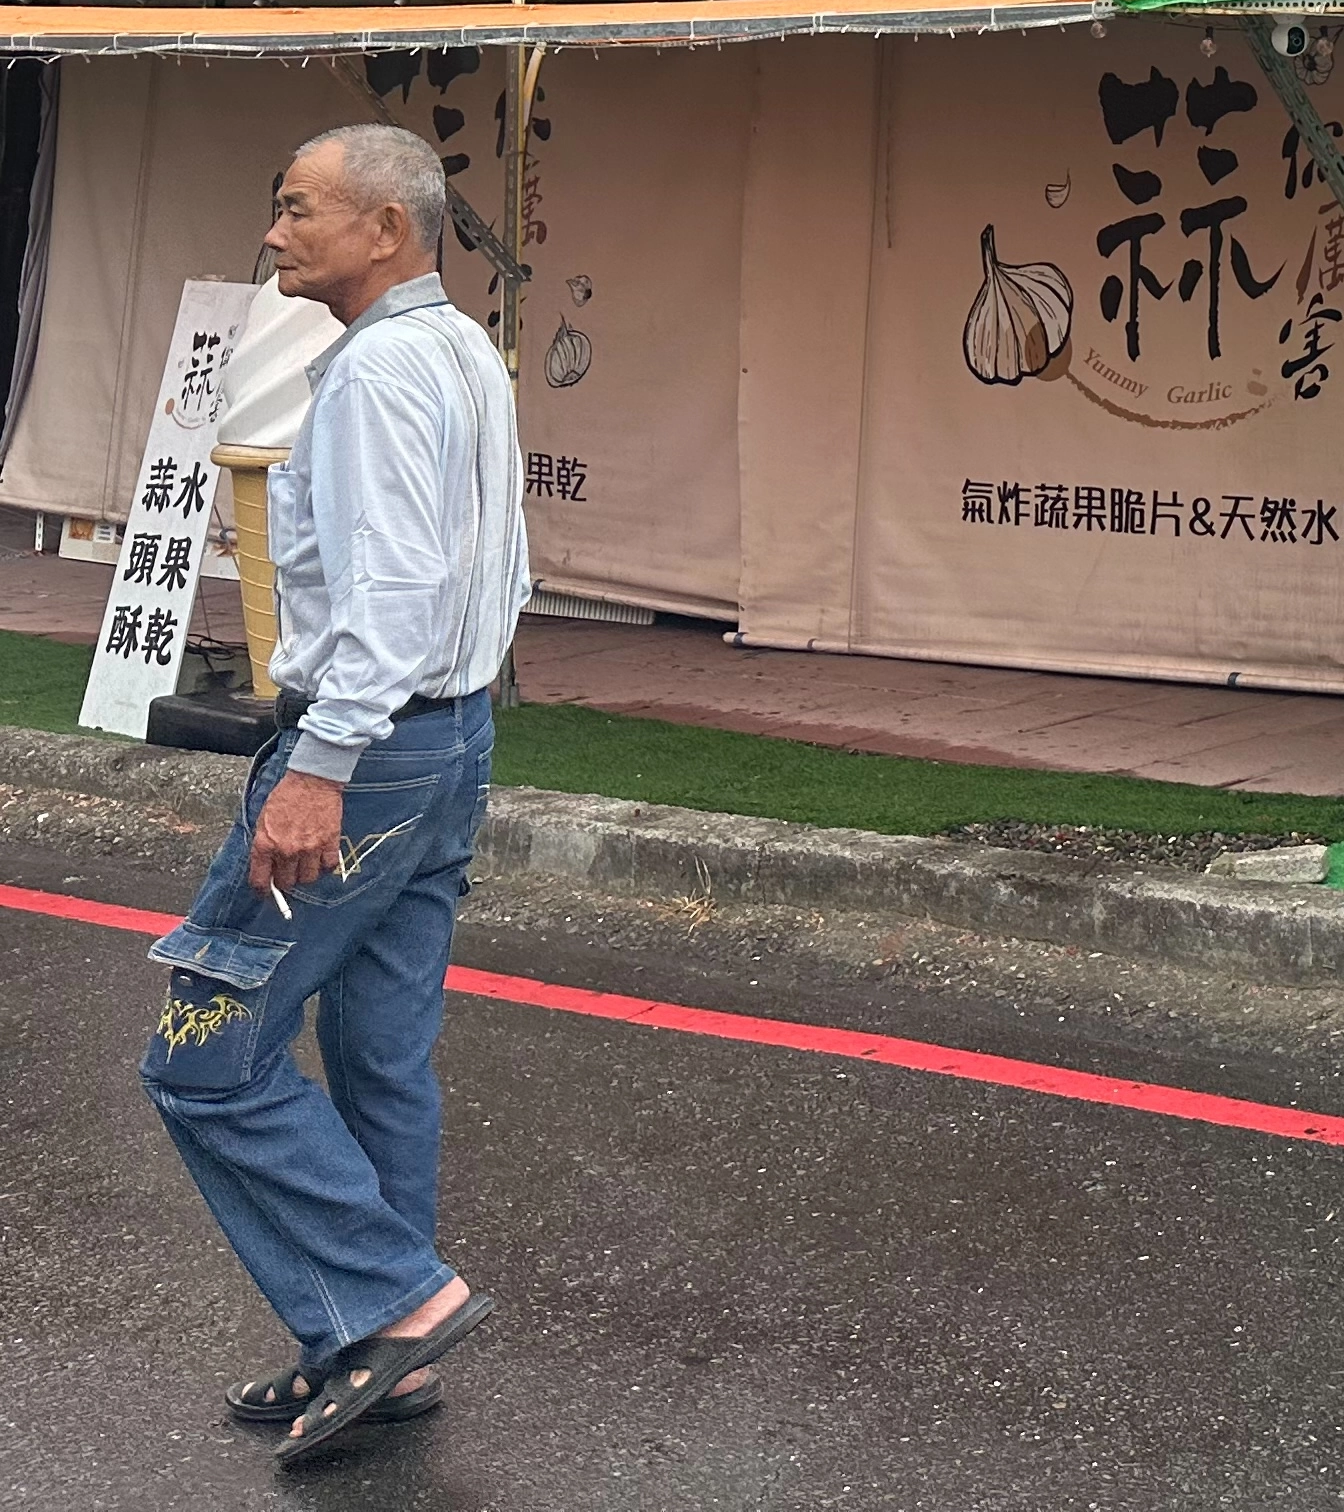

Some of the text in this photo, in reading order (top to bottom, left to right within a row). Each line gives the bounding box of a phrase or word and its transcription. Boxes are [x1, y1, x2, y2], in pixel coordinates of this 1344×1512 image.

[1097, 65, 1288, 362] 蒜
[1083, 346, 1233, 404] Yummy Garlic
